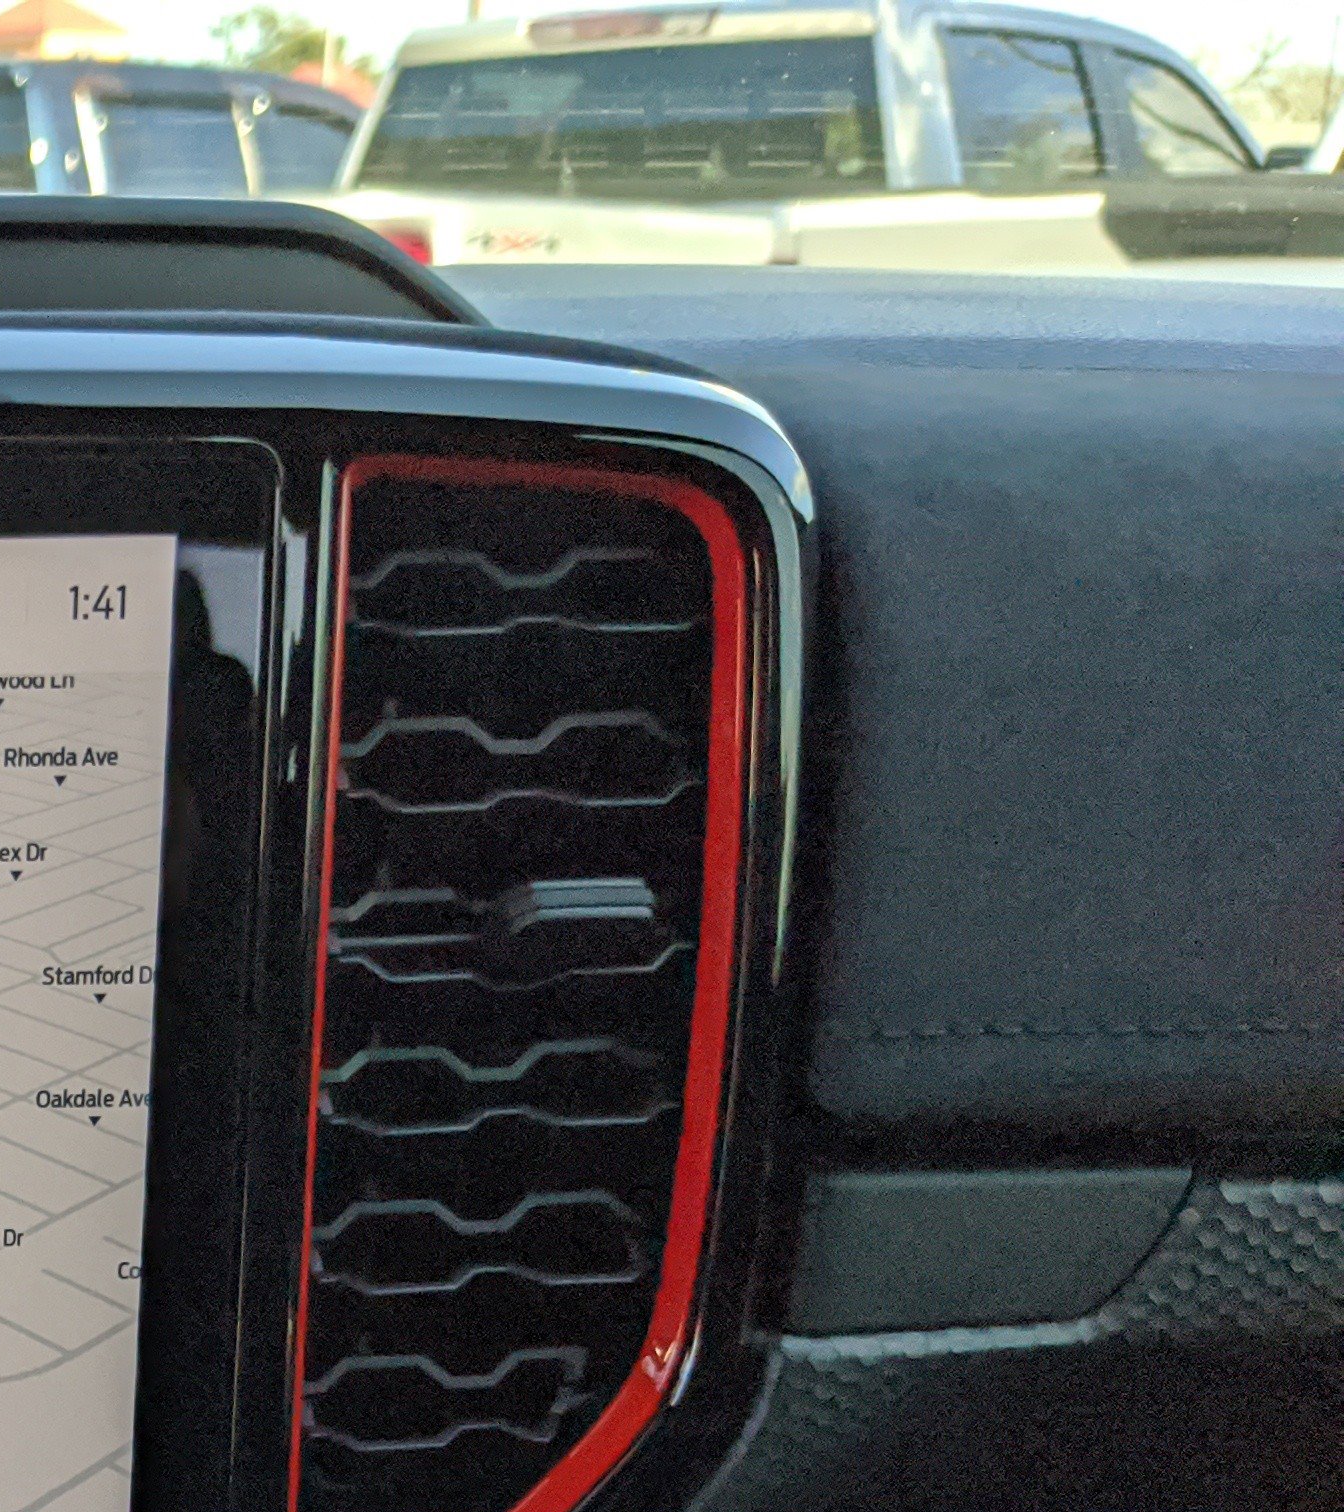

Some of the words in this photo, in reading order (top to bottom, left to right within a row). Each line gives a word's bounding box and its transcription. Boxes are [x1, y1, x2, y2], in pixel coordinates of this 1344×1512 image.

[69, 585, 127, 621] 1:41
[4, 748, 77, 768] Rhonda
[81, 748, 119, 767] Ave
[24, 843, 47, 862] Dr
[42, 965, 134, 985] Stamford
[35, 1089, 115, 1108] Oakdale
[3, 1229, 23, 1248] Dr
